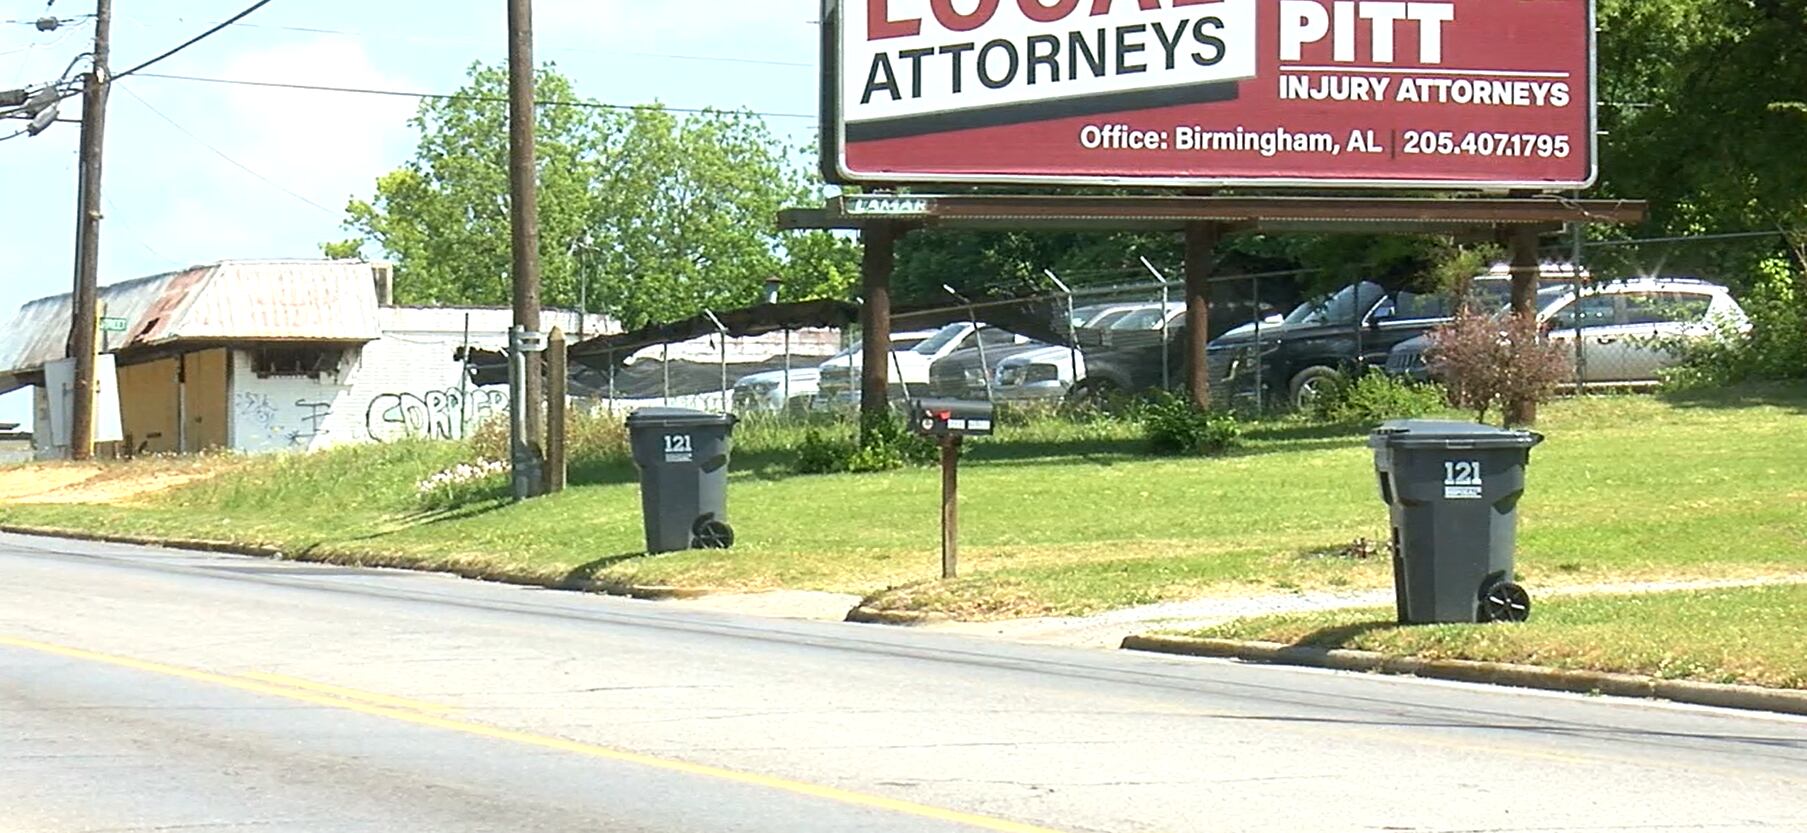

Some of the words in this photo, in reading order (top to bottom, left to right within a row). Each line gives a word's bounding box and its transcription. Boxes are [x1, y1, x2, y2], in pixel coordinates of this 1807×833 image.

[1280, 0, 1454, 64] PITT
[861, 16, 1226, 104] ATTORNEYS
[1280, 75, 1390, 101] INJURY
[1396, 78, 1570, 107] ATTORNEYS
[1080, 125, 1168, 149] Office:
[1175, 126, 1341, 156] Birmingham,
[1346, 129, 1383, 152] AL
[1403, 131, 1570, 157] 205.407.1795
[854, 199, 926, 212] LAMAR
[664, 435, 692, 452] 121
[1444, 462, 1482, 485] 121
